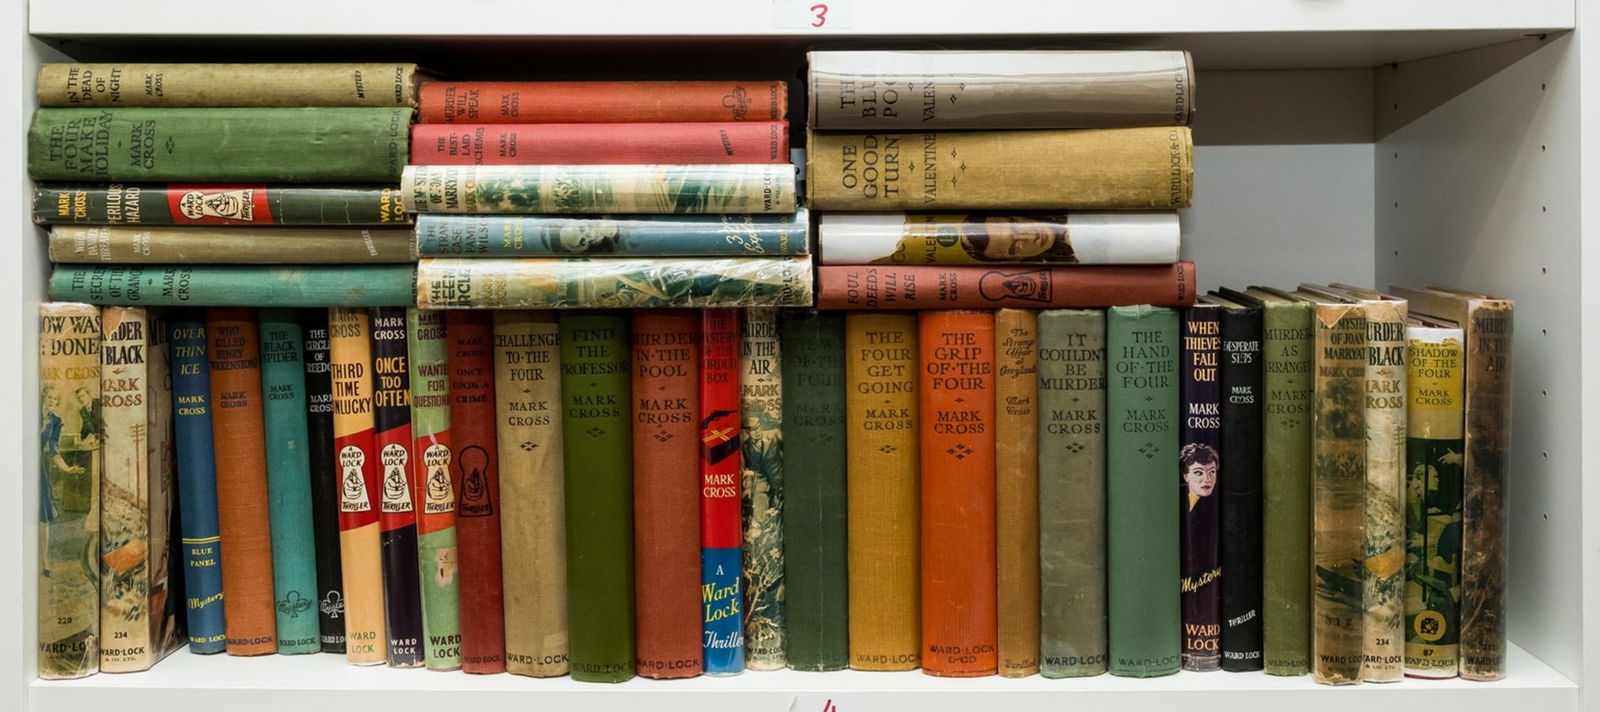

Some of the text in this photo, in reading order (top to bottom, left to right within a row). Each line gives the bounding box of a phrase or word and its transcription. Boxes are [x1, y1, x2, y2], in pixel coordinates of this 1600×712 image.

[810, 4, 828, 28] 3
[68, 67, 80, 103] IN THE
[82, 70, 93, 101] DEAD
[96, 77, 106, 93] OF
[110, 67, 121, 103] NIGHT
[145, 74, 153, 96] MARK
[155, 73, 163, 97] CROSS
[457, 92, 467, 116] WILL
[469, 89, 480, 119] SPEAK
[511, 92, 519, 117] CROSS
[51, 126, 65, 161] THE
[65, 119, 81, 170] FOUR
[81, 117, 96, 173] MAKE
[131, 122, 143, 167] MARK
[144, 120, 156, 170] CROSS
[462, 134, 470, 156] LAID
[500, 133, 508, 156] MARK
[843, 145, 857, 189] ONE
[864, 135, 878, 199] GOOD
[884, 138, 900, 199] TURN
[924, 133, 936, 205] VALENTINE
[59, 192, 70, 216] MARK
[75, 190, 87, 218] CROSS
[125, 187, 141, 223] HAZARD
[187, 194, 195, 216] WARD
[196, 195, 204, 215] LOCK
[381, 188, 391, 222] WARD
[427, 224, 436, 243] THE
[72, 271, 86, 290] THE
[885, 272, 897, 302] WILL
[938, 273, 947, 301] MARK
[109, 281, 121, 298] OF
[847, 272, 859, 305] FOUL
[866, 269, 878, 308] DEEDS
[904, 274, 916, 301] RISE
[375, 317, 404, 328] MARK
[1188, 321, 1219, 335] WHEN
[174, 328, 206, 340] OVER
[270, 331, 289, 341] THE
[309, 329, 327, 339] THE
[331, 323, 361, 338] CROSS
[374, 330, 405, 340] CROSS
[572, 328, 615, 342] FIND
[495, 333, 560, 347] CHALLENGE
[866, 331, 904, 344] THE
[942, 333, 975, 346] THE
[1067, 333, 1087, 347] IT
[1132, 331, 1163, 344] THE
[1184, 336, 1221, 350] THIEVES
[1331, 333, 1341, 344] OF
[175, 346, 206, 358] THIN
[264, 341, 296, 352] BLACK
[576, 345, 610, 358] THE
[743, 342, 752, 356] IN
[756, 342, 775, 356] THE
[1123, 346, 1170, 358] HAND
[1223, 341, 1259, 352] DESPERATE
[1281, 345, 1298, 356] AS
[1409, 347, 1458, 358] SHADOW
[106, 344, 144, 365] BLACK
[263, 351, 299, 363] SPIDER
[314, 352, 325, 362] OF
[862, 349, 912, 361] FOUR
[934, 347, 982, 361] GRIP
[1193, 353, 1217, 366] FALL
[1368, 346, 1404, 366] BLACK
[181, 364, 200, 375] ICE
[375, 357, 406, 374] ONCE
[749, 360, 771, 375] AIR
[1412, 358, 1457, 368] OF THE
[332, 363, 364, 379] THIRD
[511, 368, 544, 381] FOUR
[640, 365, 687, 378] POOL
[867, 365, 905, 377] GET
[1065, 364, 1087, 376] BE
[1193, 368, 1216, 381] OUT
[1418, 368, 1451, 378] FOUR
[270, 384, 293, 392] MARK
[335, 381, 360, 397] TIME
[381, 376, 402, 389] TOO
[427, 380, 445, 392] FOR
[858, 381, 914, 394] GOING
[932, 377, 986, 390] FOUR
[1123, 376, 1169, 389] FOUR
[221, 391, 246, 400] MARK
[269, 392, 294, 401] CROSS
[743, 384, 779, 397] MARK
[1418, 389, 1449, 397] MARK
[178, 395, 205, 404] MARK
[220, 400, 248, 409] CROSS
[375, 389, 411, 407] OFTEN
[456, 395, 487, 404] CRIME
[573, 395, 616, 405] MARK
[640, 399, 689, 410] MARK
[1006, 396, 1030, 405] Mark
[1415, 398, 1452, 406] CROSS
[178, 407, 206, 416] CROSS
[510, 401, 549, 411] MARK
[1006, 405, 1031, 415] Cross
[1189, 403, 1219, 415] MARK
[569, 408, 620, 419] CROSS
[638, 412, 692, 424] CROSS
[865, 408, 910, 419] MARK
[937, 410, 981, 422] MARK
[1052, 410, 1097, 420] MARK
[1126, 409, 1167, 420] MARK
[508, 416, 550, 426] CROSS
[863, 420, 913, 431] CROSS
[1122, 421, 1169, 433] CROSS
[1187, 416, 1220, 429] CROSS
[934, 423, 985, 434] CROSS
[1047, 423, 1101, 435] CROSS
[383, 450, 405, 458] WARD
[426, 450, 449, 458] WARD
[342, 459, 362, 467] LOCK
[384, 458, 405, 466] LOCK
[427, 458, 449, 466] LOCK
[704, 474, 735, 484] MARK
[703, 486, 736, 498] CROSS
[192, 547, 213, 555] BLUE
[191, 559, 216, 567] PANEL
[716, 565, 725, 575] A
[1181, 566, 1222, 593] Mystery
[702, 577, 739, 602] Ward
[188, 592, 225, 610] Mystery
[705, 603, 739, 622] Lock
[350, 631, 376, 640] WARD
[1185, 624, 1220, 636] WARD
[391, 638, 417, 646] WARD
[430, 634, 461, 646] WARD
[1187, 638, 1219, 650] LOCK
[1375, 638, 1389, 646] 234
[352, 644, 375, 654] LOCK
[434, 647, 461, 658] LOCK
